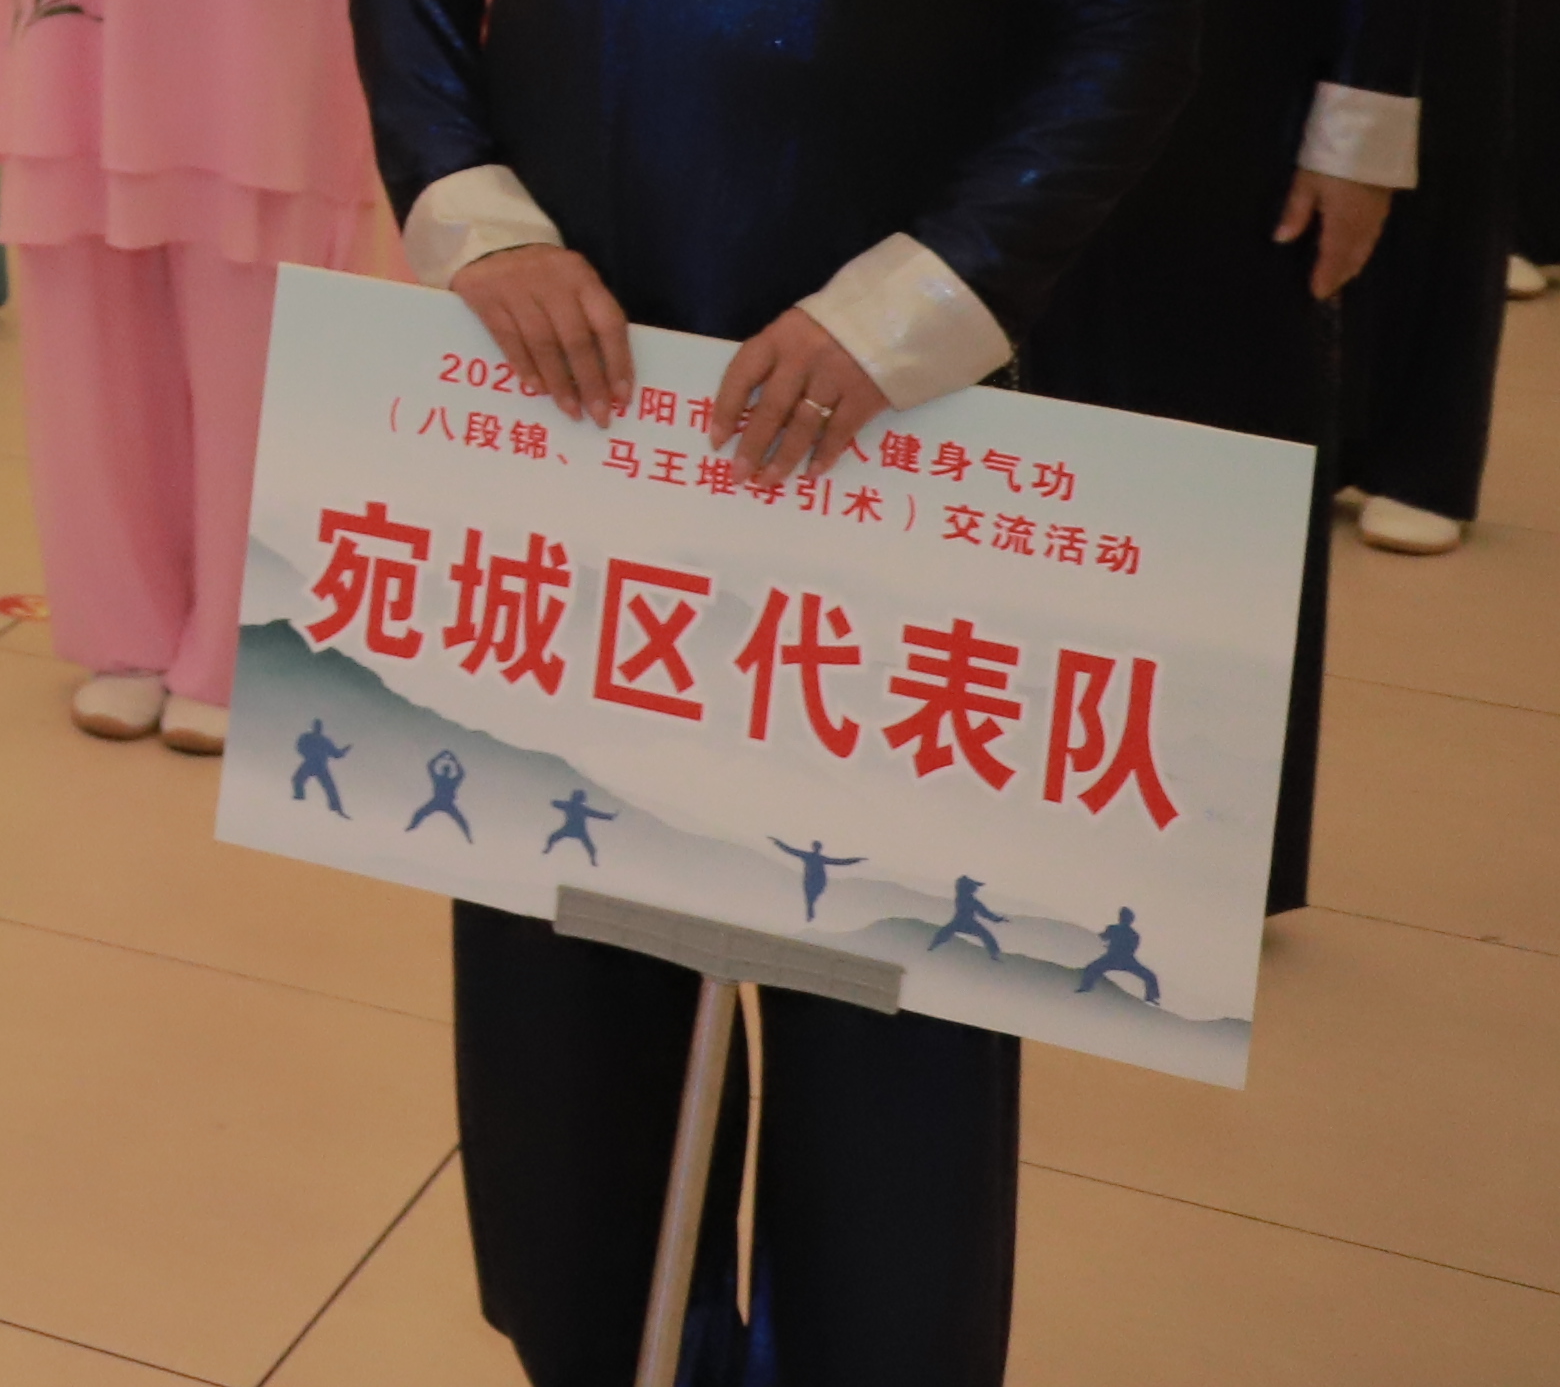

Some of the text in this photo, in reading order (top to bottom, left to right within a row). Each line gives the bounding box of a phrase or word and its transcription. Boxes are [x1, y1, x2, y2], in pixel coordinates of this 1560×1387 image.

[439, 351, 1077, 502] 202阳市健身气功
[304, 499, 1182, 833] 宛城区代表队
